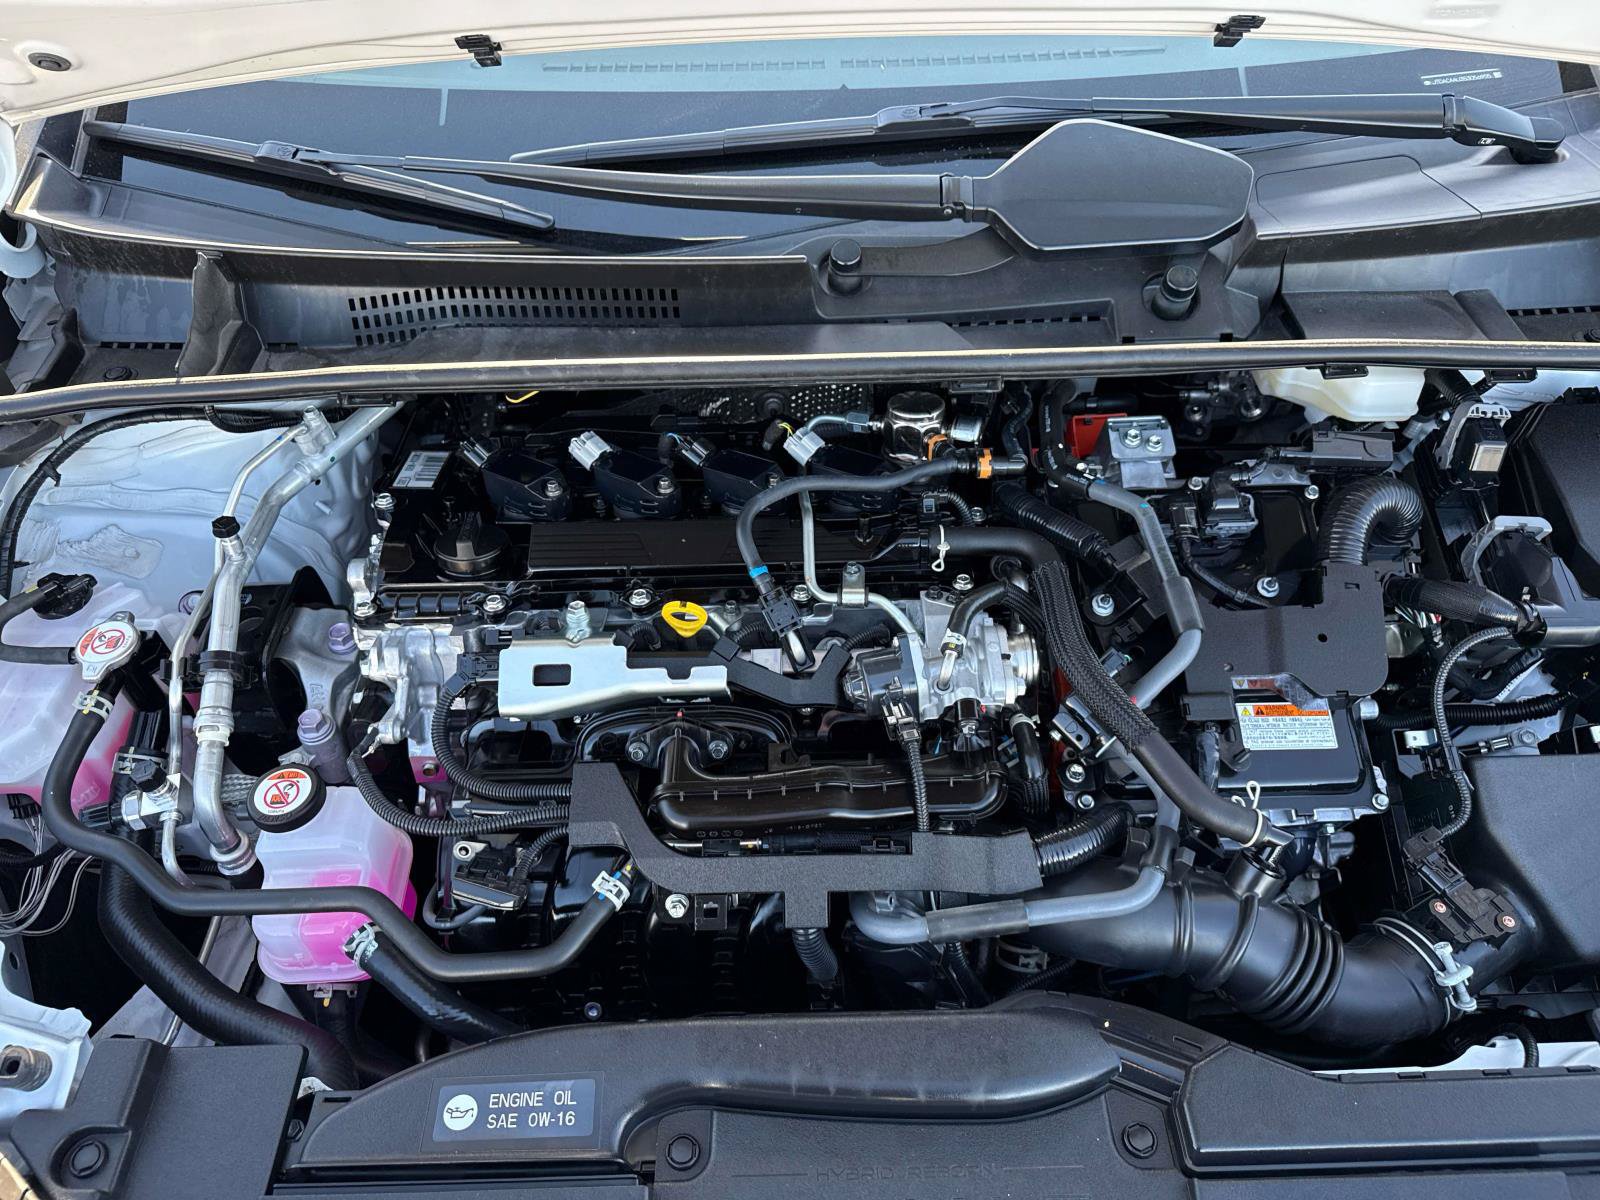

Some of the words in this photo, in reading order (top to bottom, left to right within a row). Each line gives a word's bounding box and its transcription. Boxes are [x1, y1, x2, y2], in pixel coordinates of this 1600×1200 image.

[489, 1092, 544, 1108] ENGINE
[554, 1090, 577, 1106] OIL
[486, 1113, 518, 1129] SAE
[528, 1111, 576, 1128] 0W-16
[816, 1166, 894, 1182] HYBRID
[907, 1163, 992, 1180] REBORN
